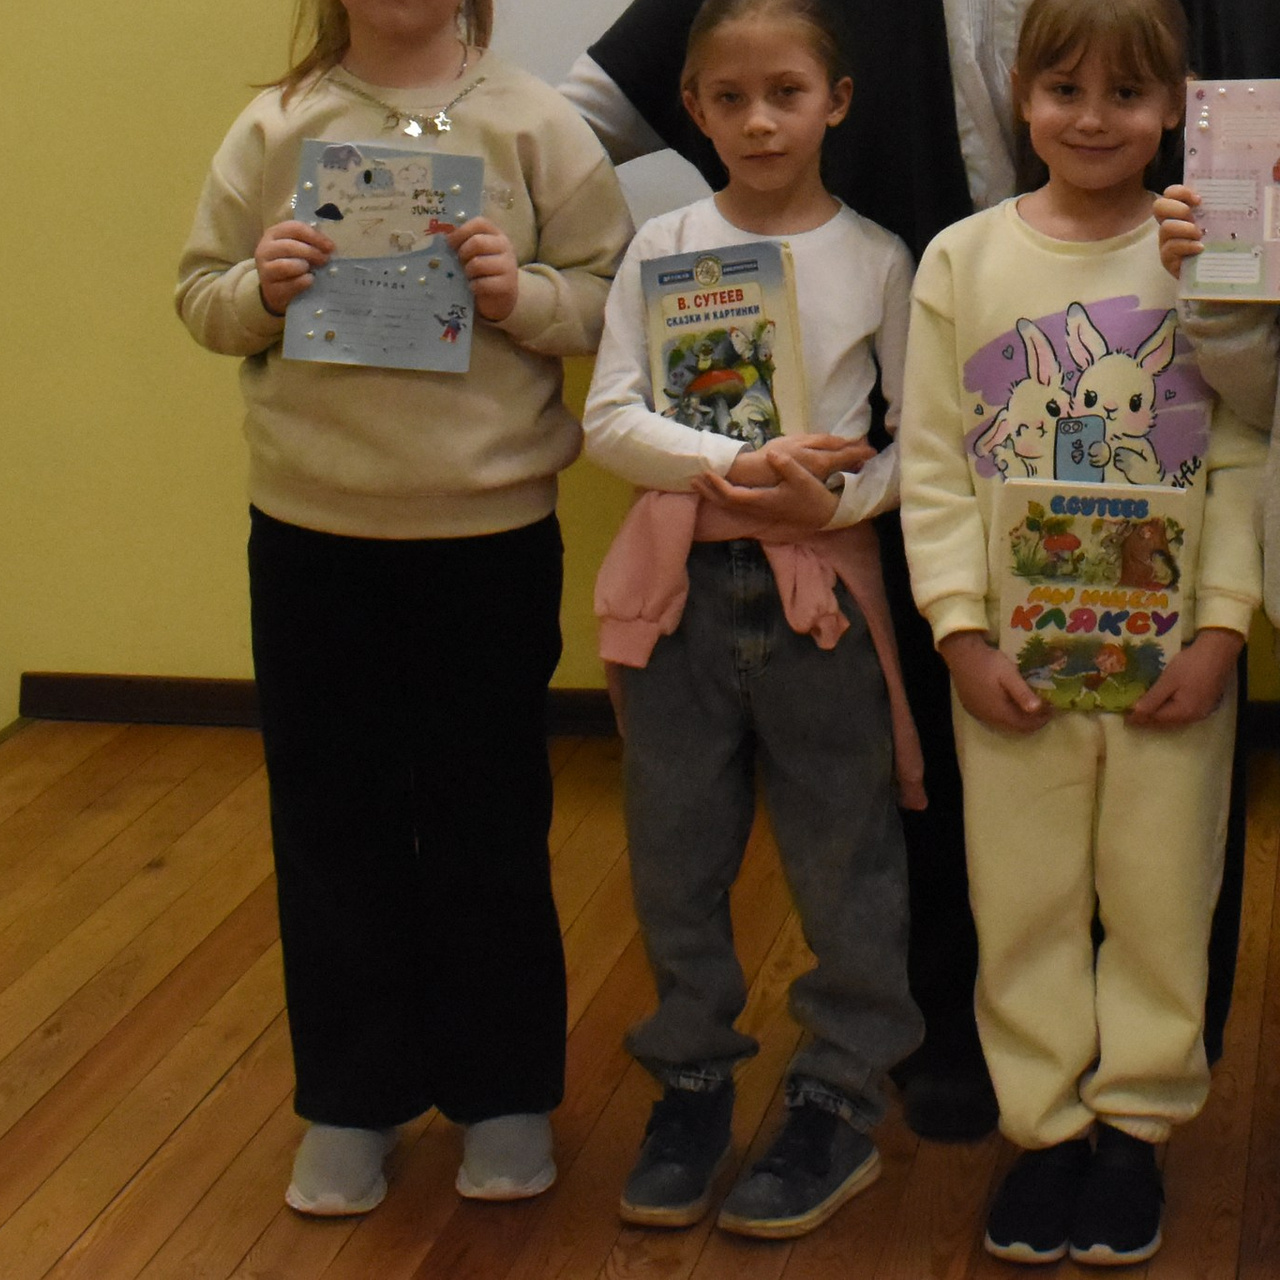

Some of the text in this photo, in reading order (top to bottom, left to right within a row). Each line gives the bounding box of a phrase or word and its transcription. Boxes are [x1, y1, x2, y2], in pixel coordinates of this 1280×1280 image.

[677, 289, 744, 311] В. СУТЕЕВ
[666, 304, 761, 327] СКАЗКИ И КАРТИНКИ
[1010, 604, 1179, 637] КЛЯКСУ
